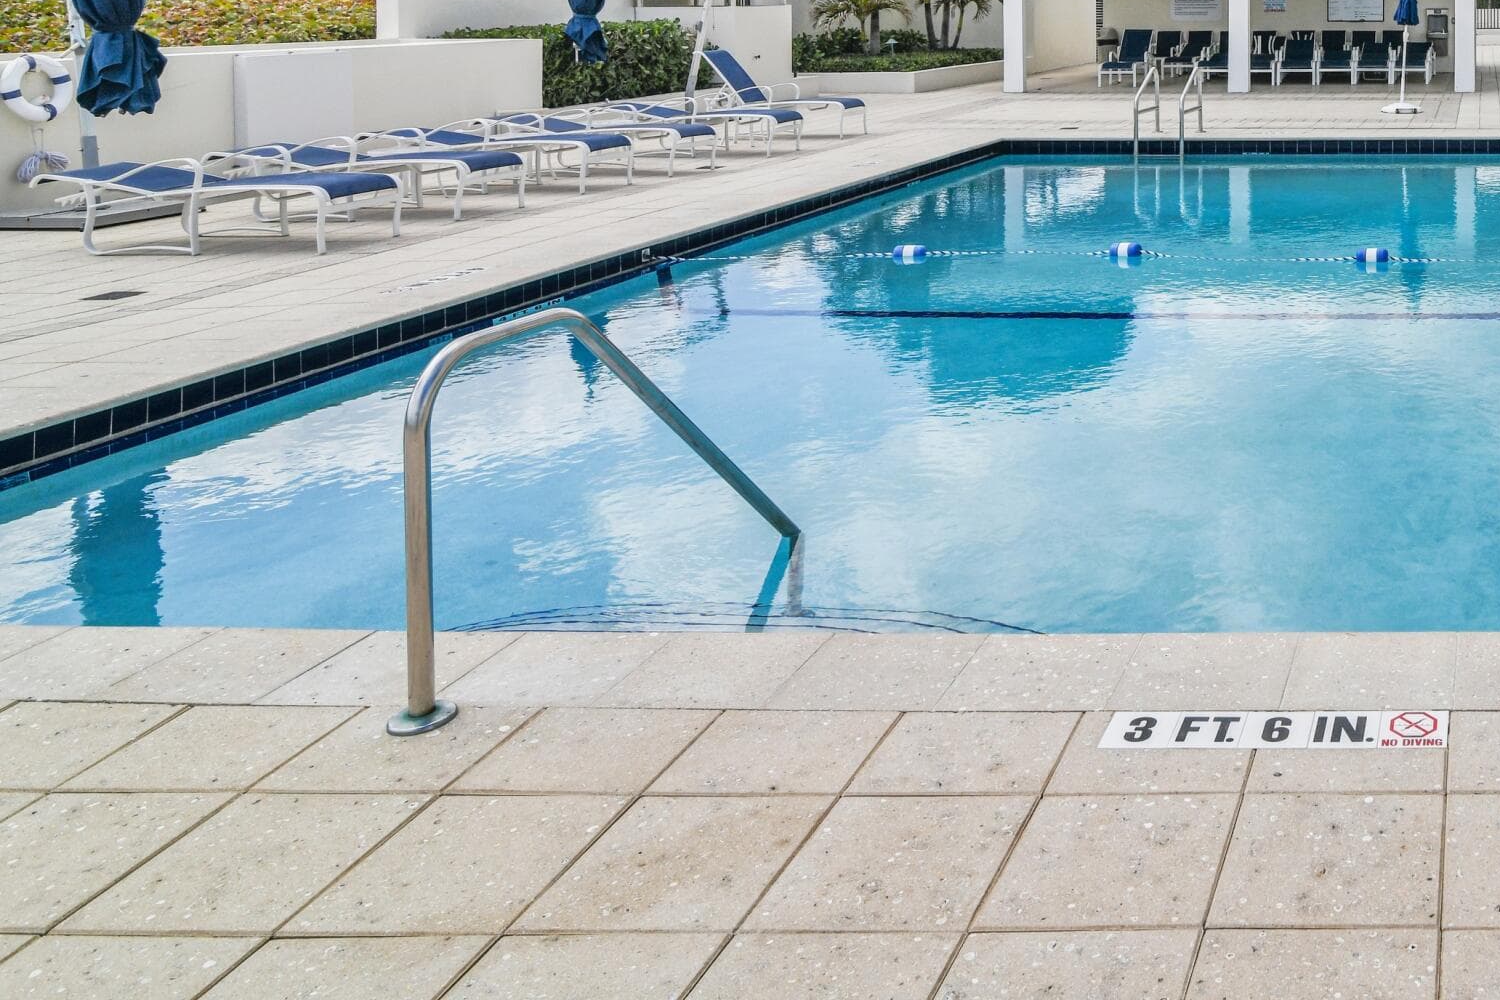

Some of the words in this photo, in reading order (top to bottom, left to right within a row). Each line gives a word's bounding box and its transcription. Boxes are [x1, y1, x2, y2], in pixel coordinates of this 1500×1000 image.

[1123, 716, 1158, 743] 3
[1174, 716, 1241, 743] FT.
[1261, 716, 1293, 743] 6
[1312, 716, 1375, 743] IN.
[1381, 738, 1398, 747] NO
[1402, 738, 1443, 747] DIVING
